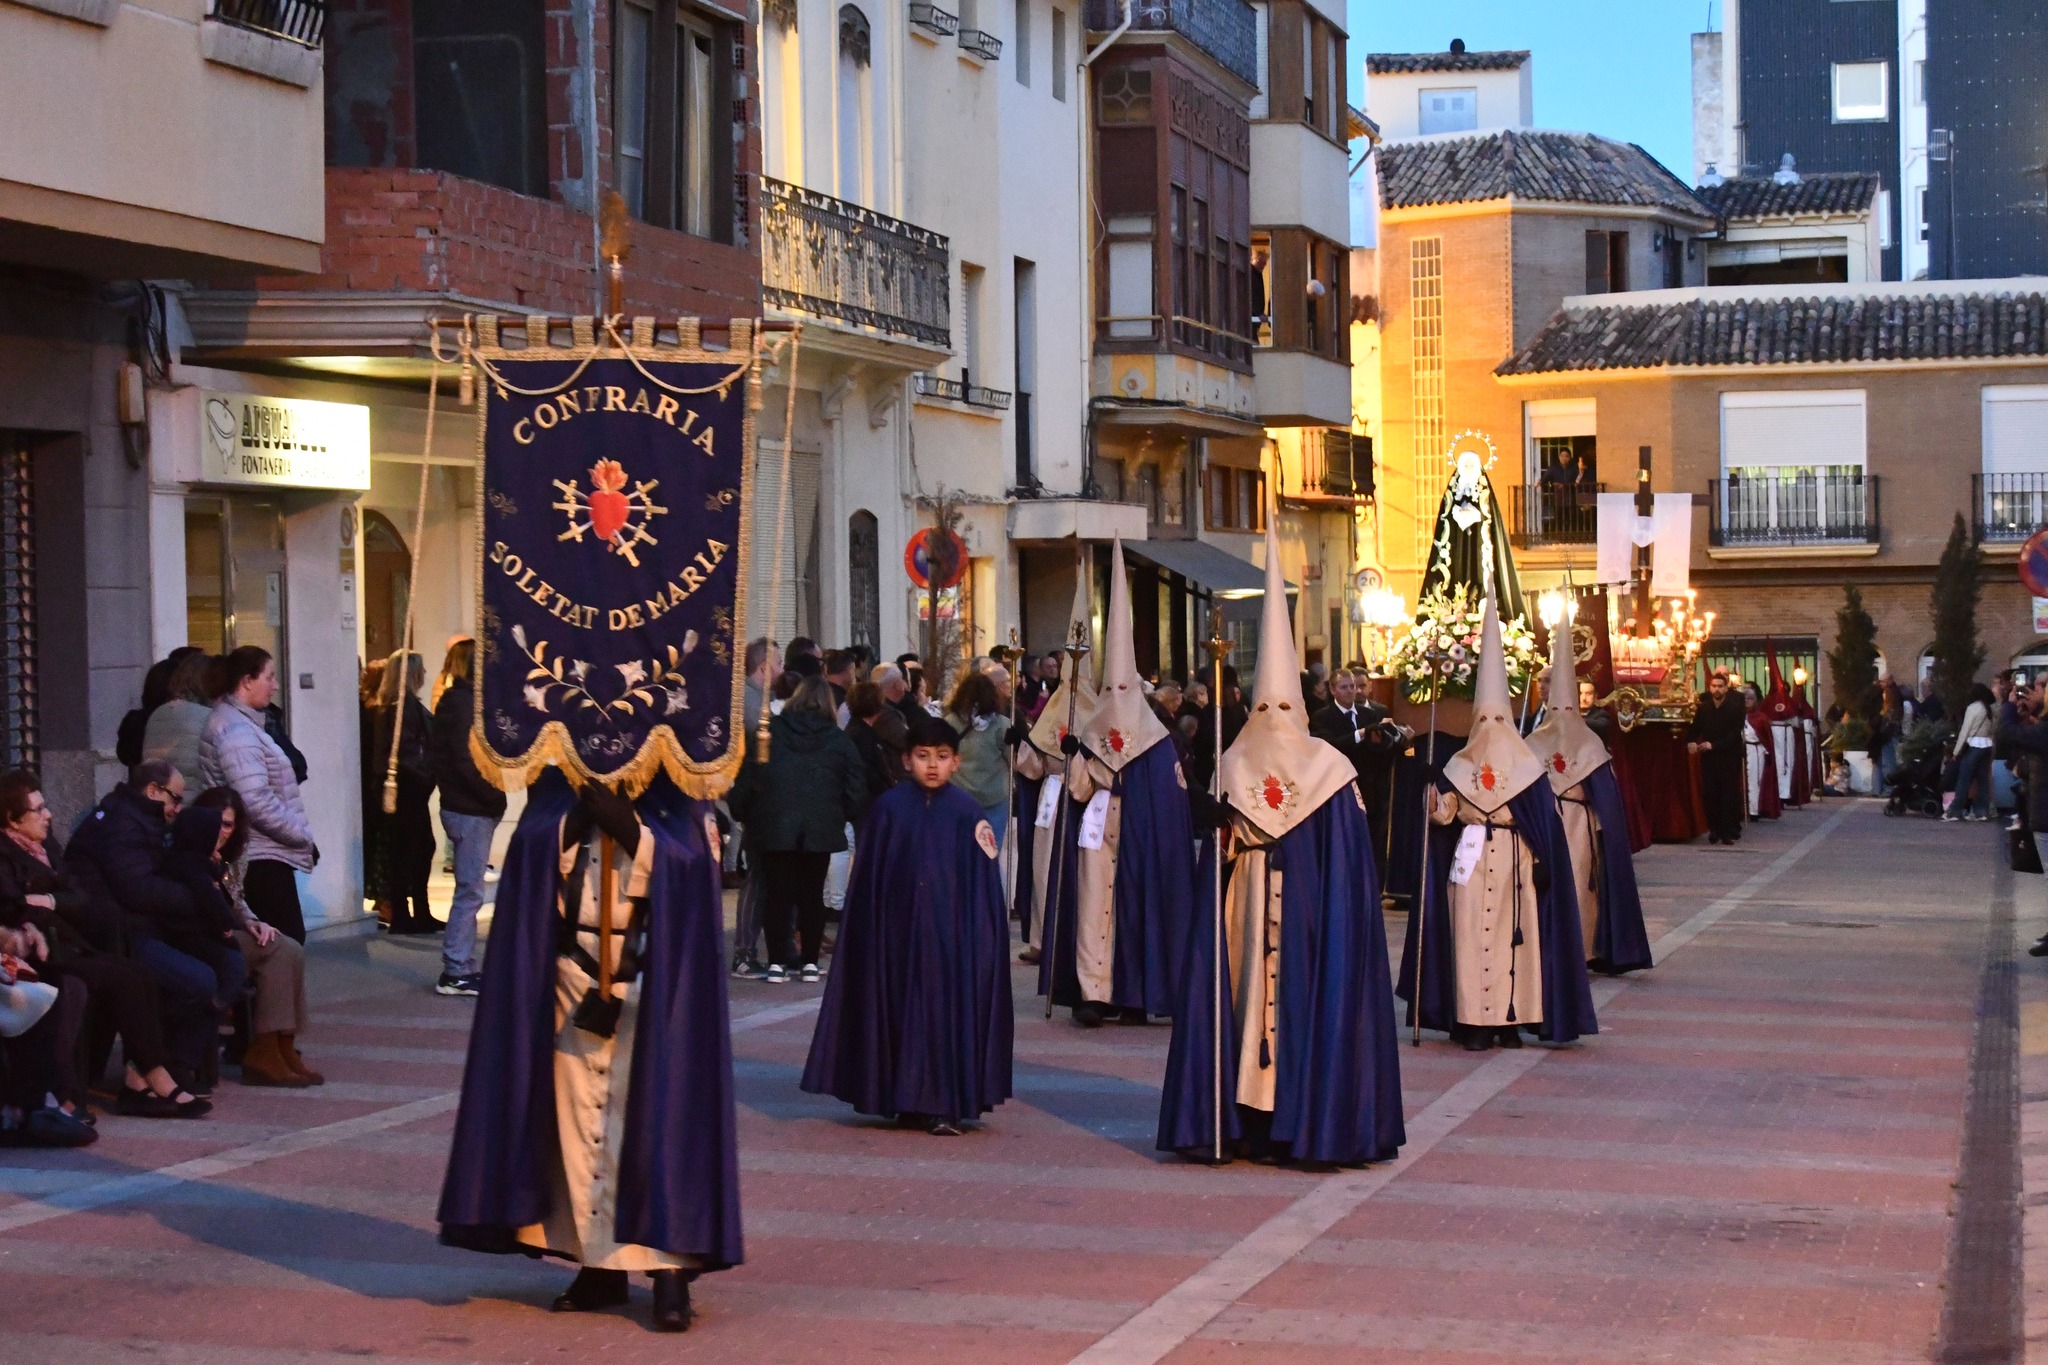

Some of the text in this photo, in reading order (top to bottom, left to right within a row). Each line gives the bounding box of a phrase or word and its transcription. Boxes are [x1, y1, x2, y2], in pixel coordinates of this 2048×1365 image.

[513, 385, 715, 456] CONFRARIA
[489, 538, 729, 631] SOLETAT DE MARIA
[1361, 577, 1376, 587] 20
